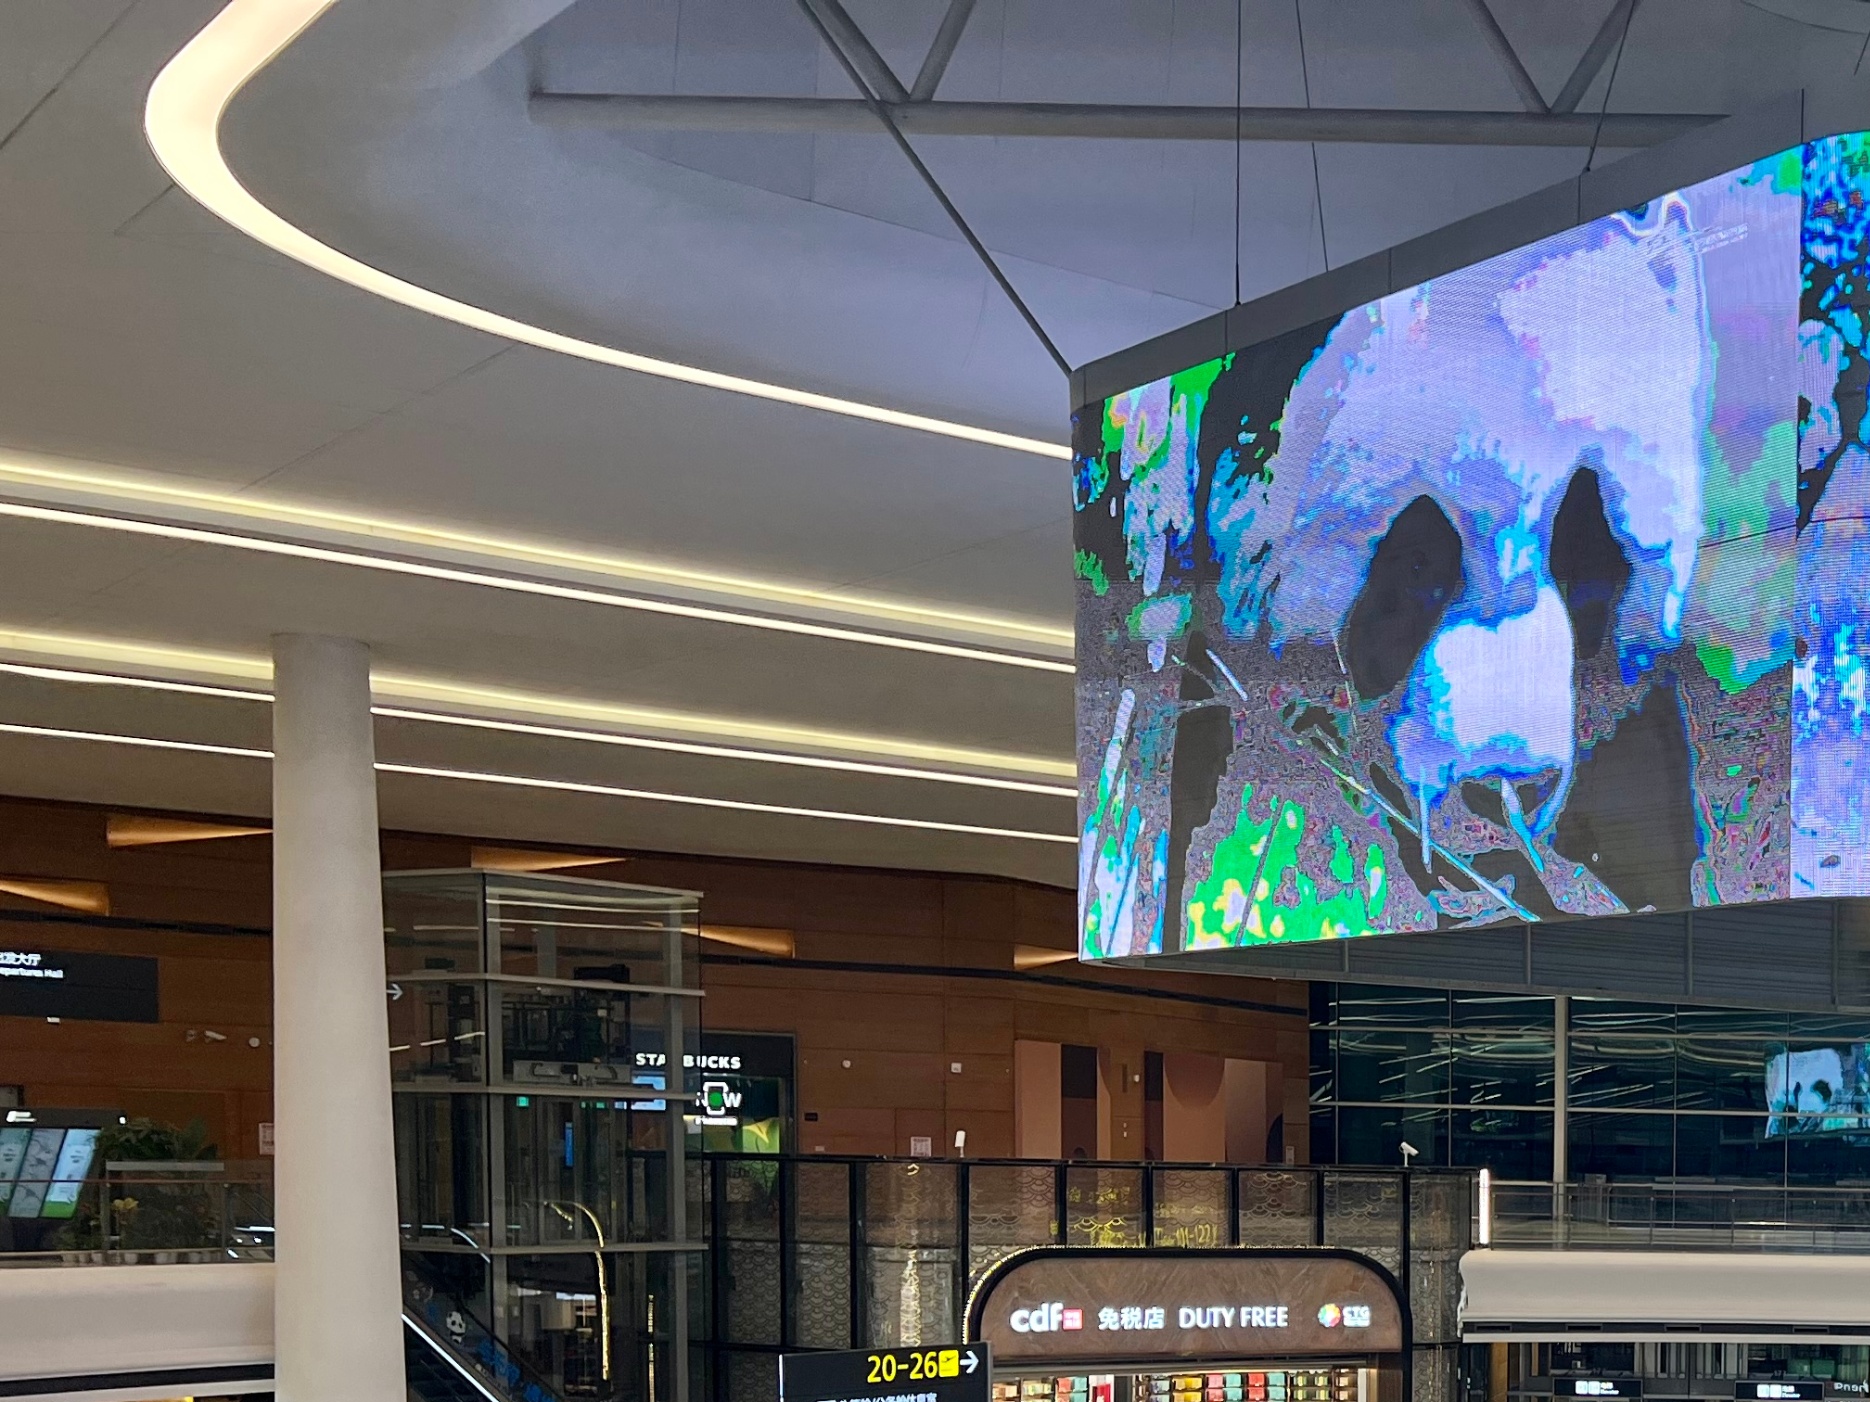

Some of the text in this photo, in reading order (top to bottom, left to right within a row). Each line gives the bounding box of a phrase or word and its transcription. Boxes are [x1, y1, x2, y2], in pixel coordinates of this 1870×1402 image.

[635, 1052, 741, 1069] STABUCKS
[1010, 1302, 1064, 1333] cdf
[1098, 1306, 1165, 1331] 免税店
[1178, 1306, 1288, 1329] DUTY FREE
[867, 1351, 938, 1384] 20-26
